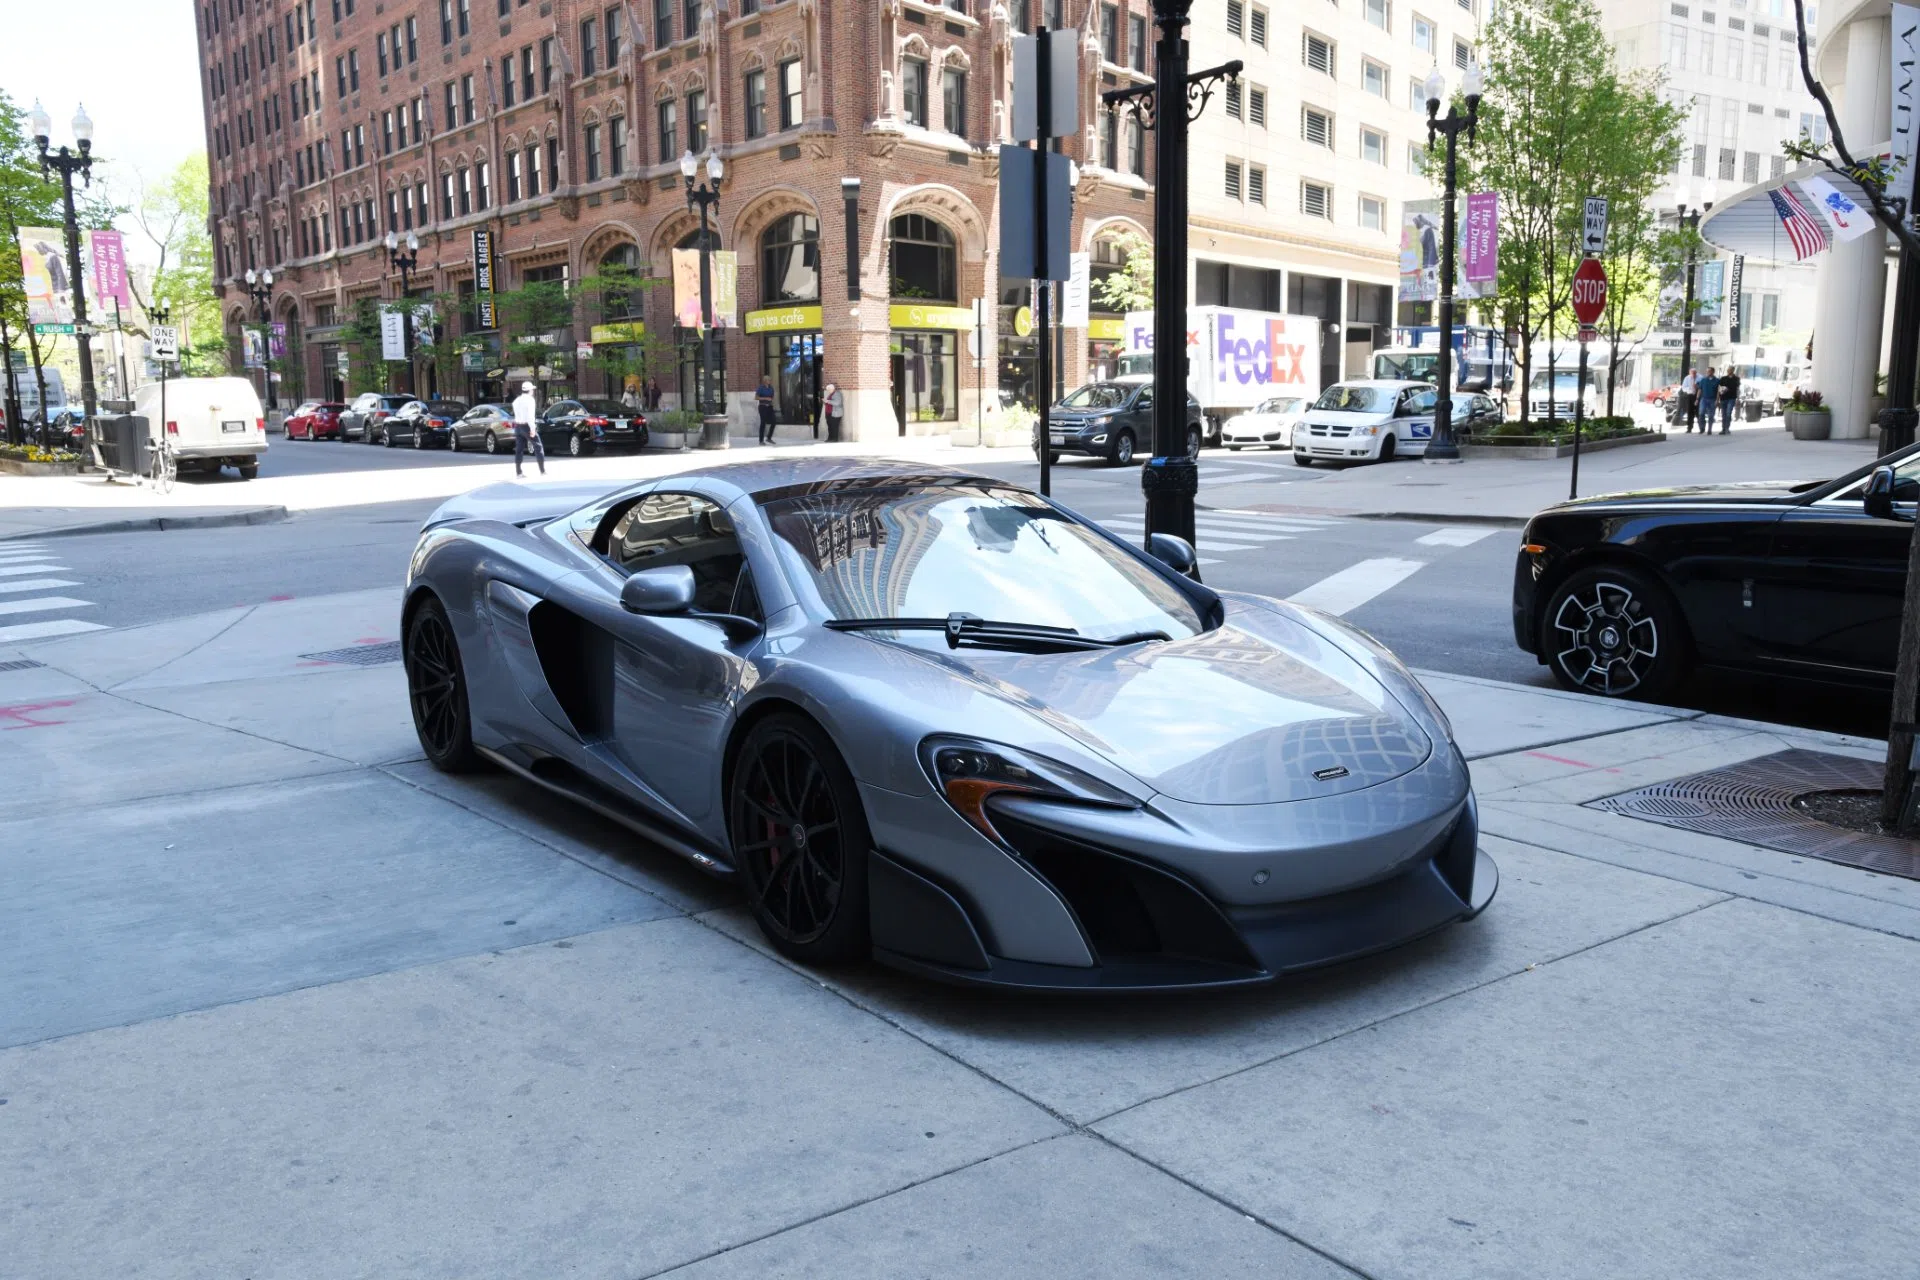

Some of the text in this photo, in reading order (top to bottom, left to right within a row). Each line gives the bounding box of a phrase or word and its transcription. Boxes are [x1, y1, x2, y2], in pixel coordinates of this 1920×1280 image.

[1894, 25, 1917, 160] LUMA
[1482, 209, 1492, 228] Her
[1587, 202, 1605, 216] ONE
[1469, 209, 1480, 265] My Dreams
[1586, 217, 1603, 231] WAY
[96, 243, 106, 259] My
[477, 232, 489, 264] BAGELS
[1480, 229, 1491, 257] Story,
[98, 260, 109, 294] Dreams
[108, 244, 120, 288] Her Story,
[1574, 279, 1605, 304] STOP
[1730, 254, 1741, 328] NORDSTROM rack
[481, 289, 492, 327] EINST
[781, 307, 805, 325] café
[43, 324, 64, 333] RUSH
[154, 328, 174, 338] ONE
[387, 317, 398, 345] LUM
[1133, 327, 1200, 350] Fex
[154, 338, 175, 347] WAY
[1217, 314, 1306, 385] FedEx
